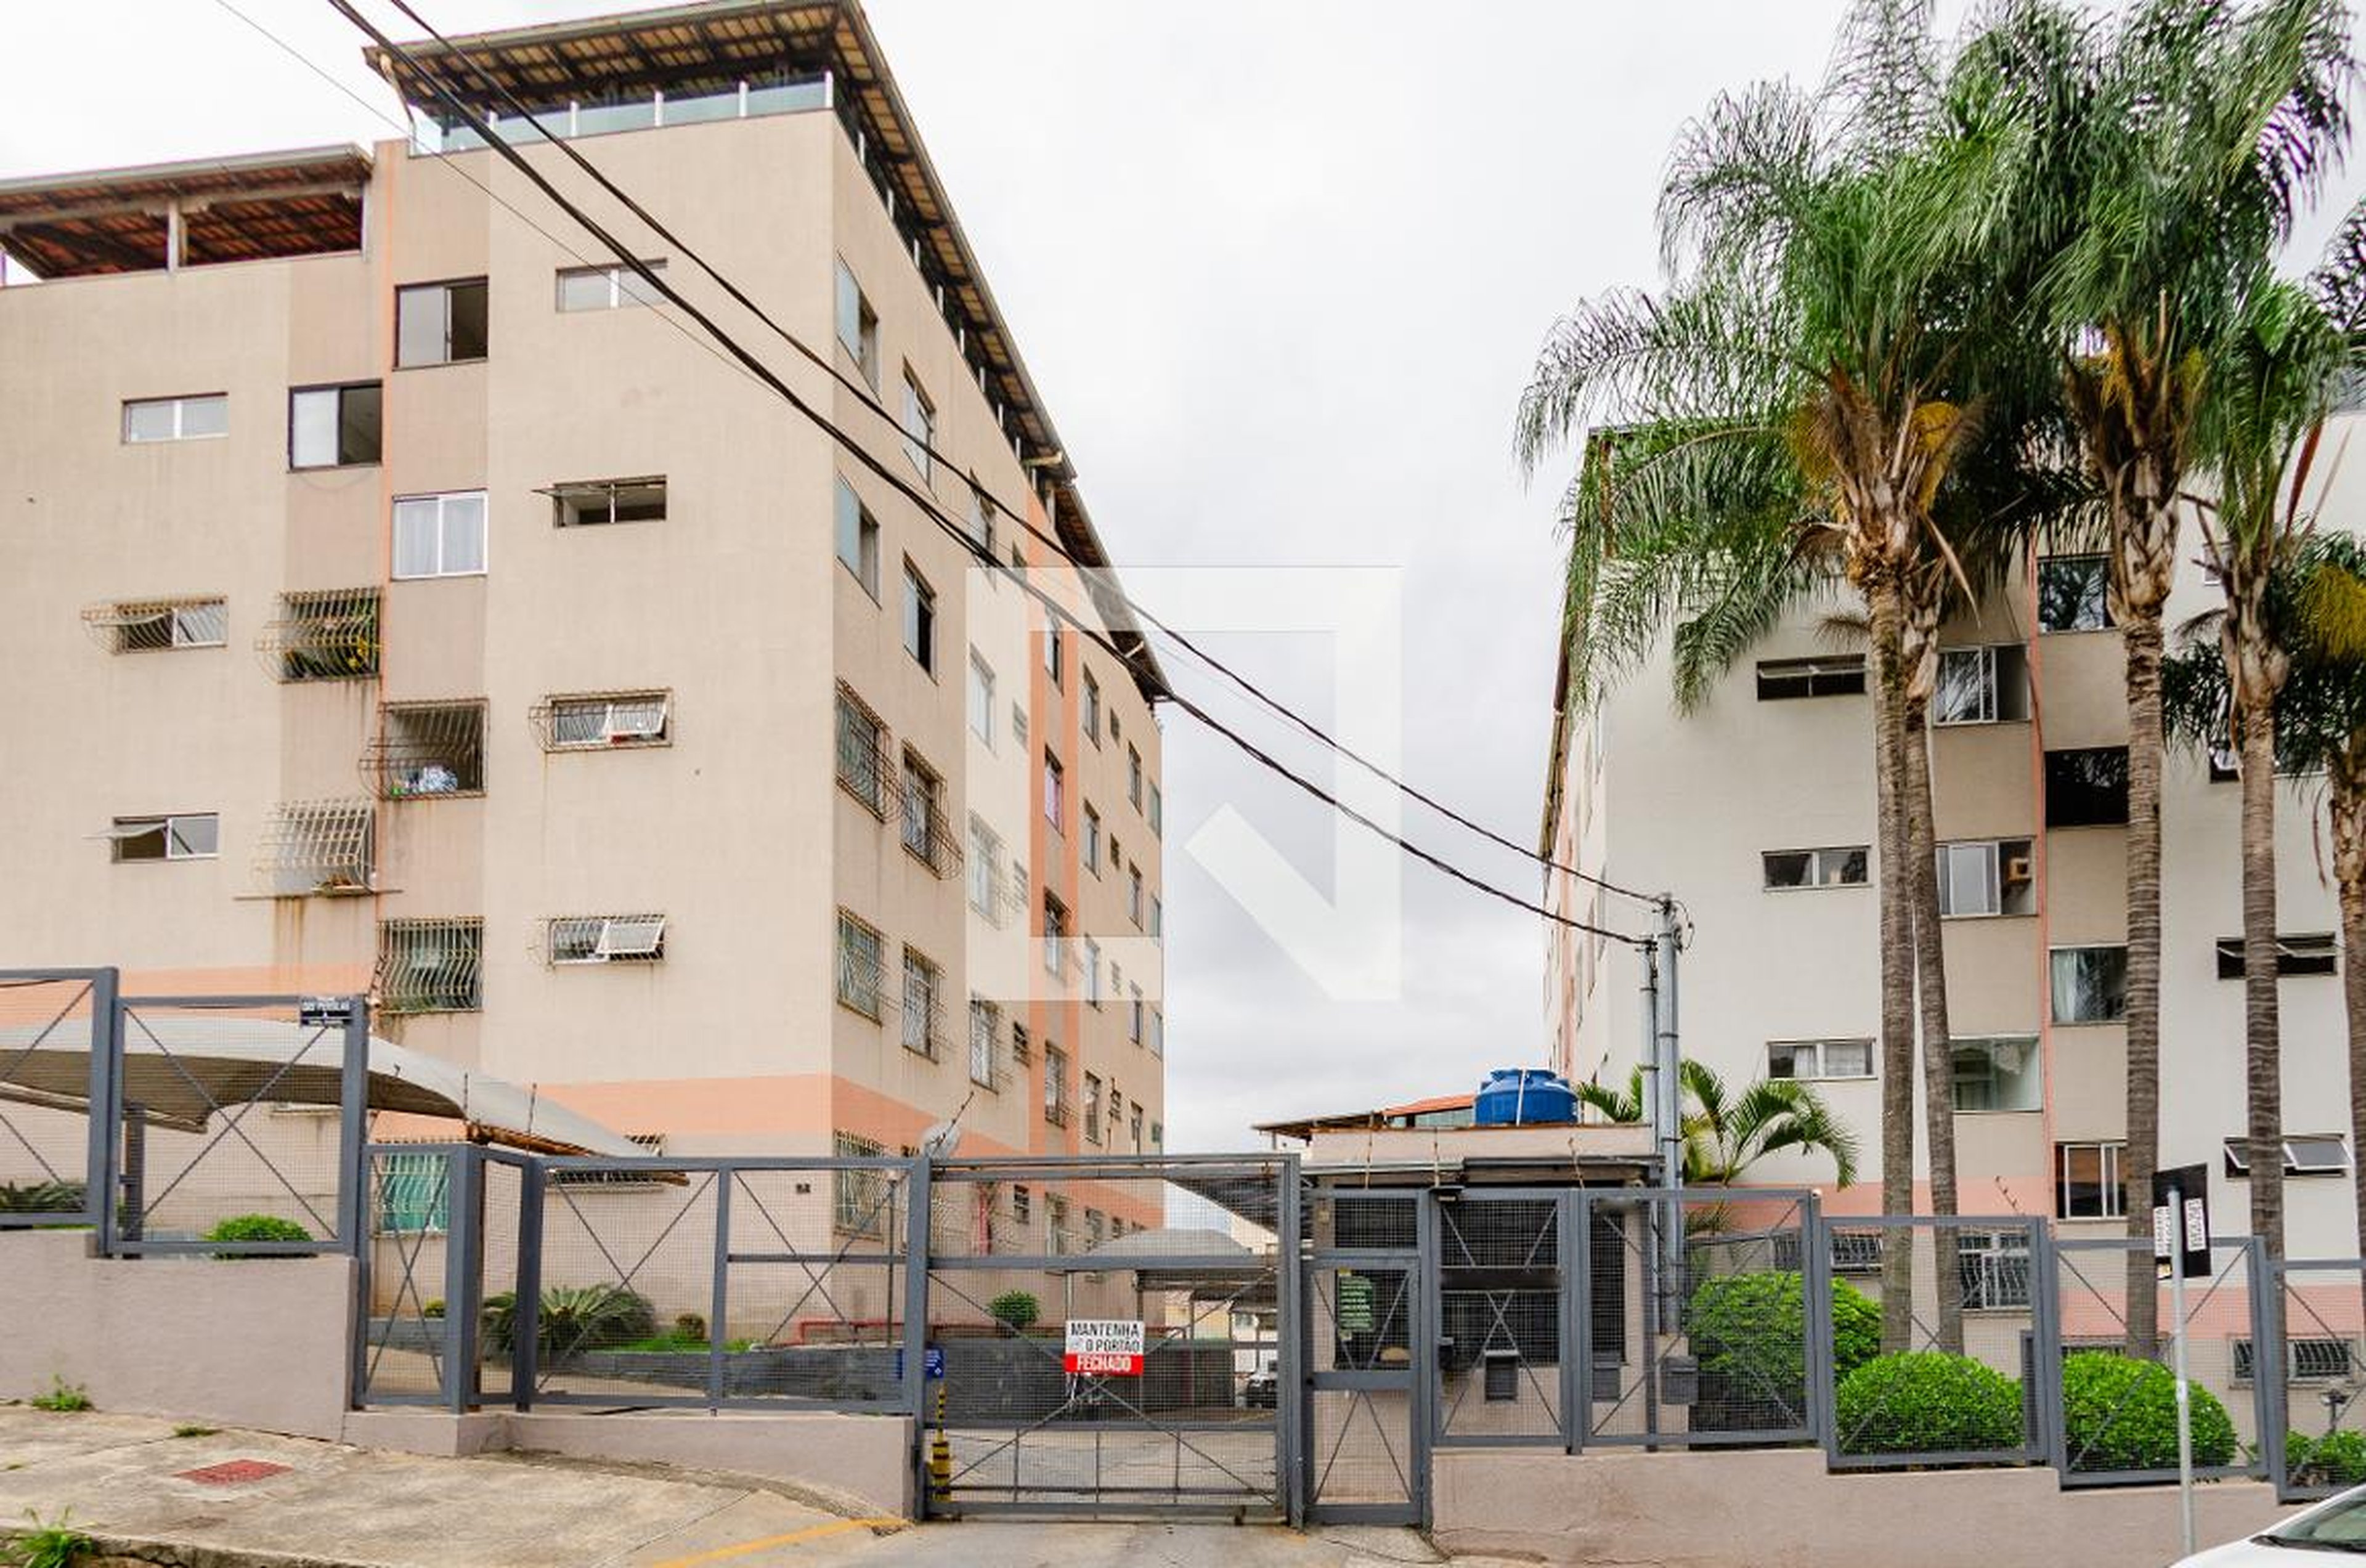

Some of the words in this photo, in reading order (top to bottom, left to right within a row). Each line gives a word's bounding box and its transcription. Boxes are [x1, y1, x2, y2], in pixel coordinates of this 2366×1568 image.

[1071, 1323, 1139, 1336] MANTENHA
[1086, 1339, 1093, 1351] O
[1078, 1355, 1132, 1371] FECHADO
